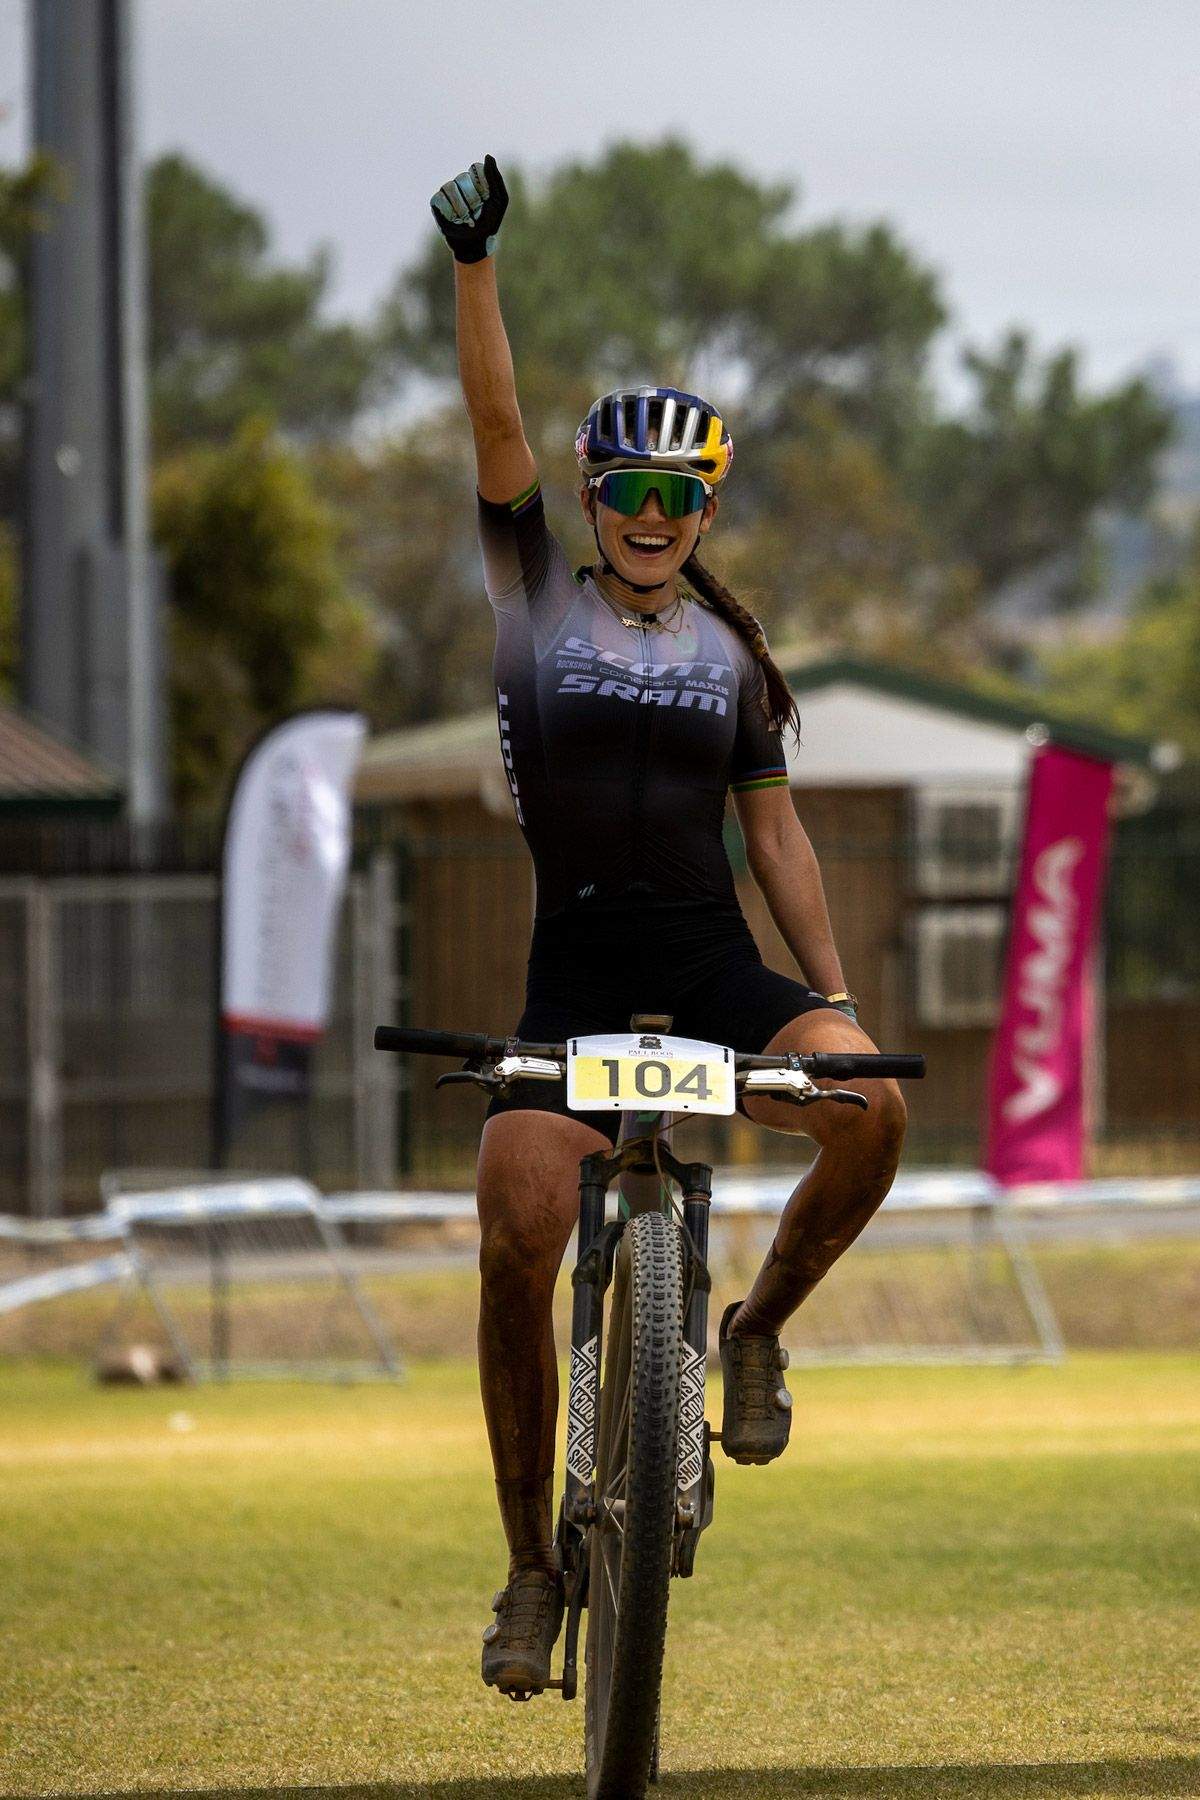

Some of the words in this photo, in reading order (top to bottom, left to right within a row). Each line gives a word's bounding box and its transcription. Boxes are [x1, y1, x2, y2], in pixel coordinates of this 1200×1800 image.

[555, 637, 732, 681] SCOTT
[557, 674, 727, 716] SRAM
[602, 1060, 712, 1100] 104
